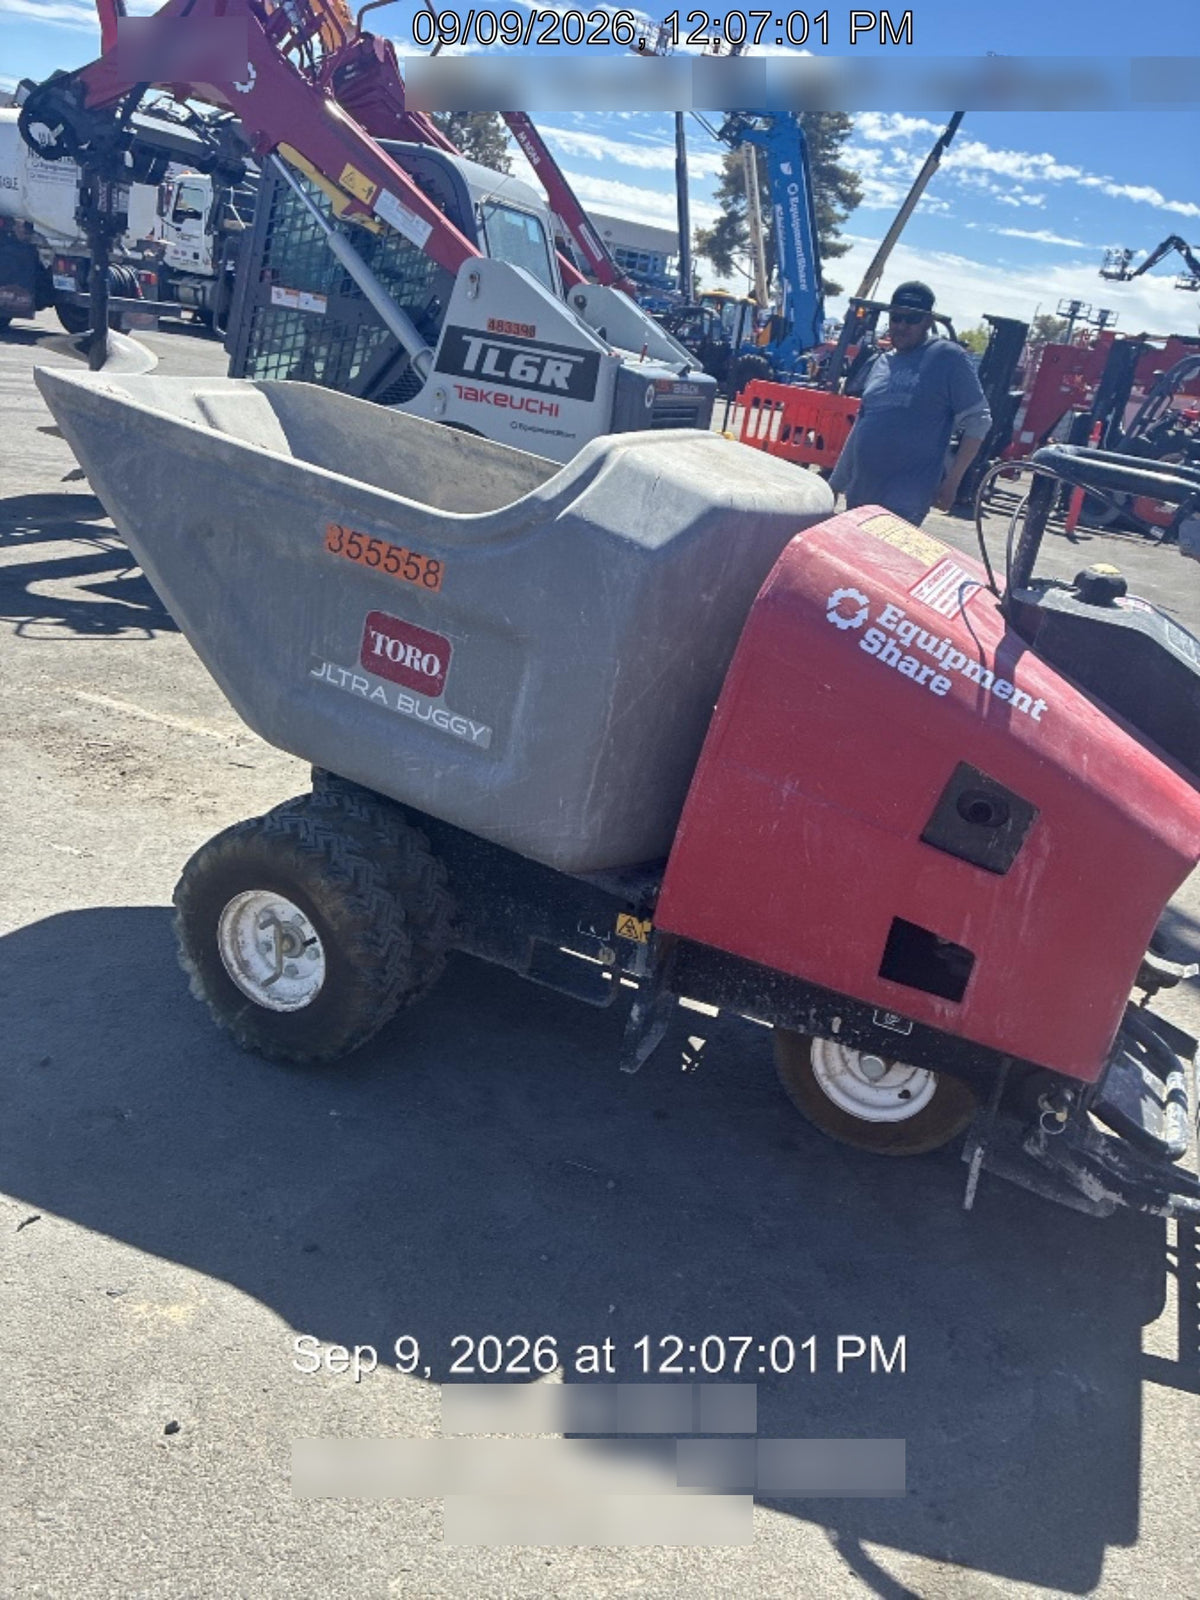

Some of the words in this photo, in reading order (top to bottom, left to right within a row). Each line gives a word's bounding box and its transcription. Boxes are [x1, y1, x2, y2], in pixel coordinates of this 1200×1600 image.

[461, 335, 586, 390] TL6R
[453, 385, 560, 418] TAKEUCHI
[327, 524, 441, 588] 355558
[370, 630, 441, 676] TORO
[859, 627, 952, 697] Share
[875, 603, 1048, 722] Equipment
[397, 695, 485, 741] BUGGY
